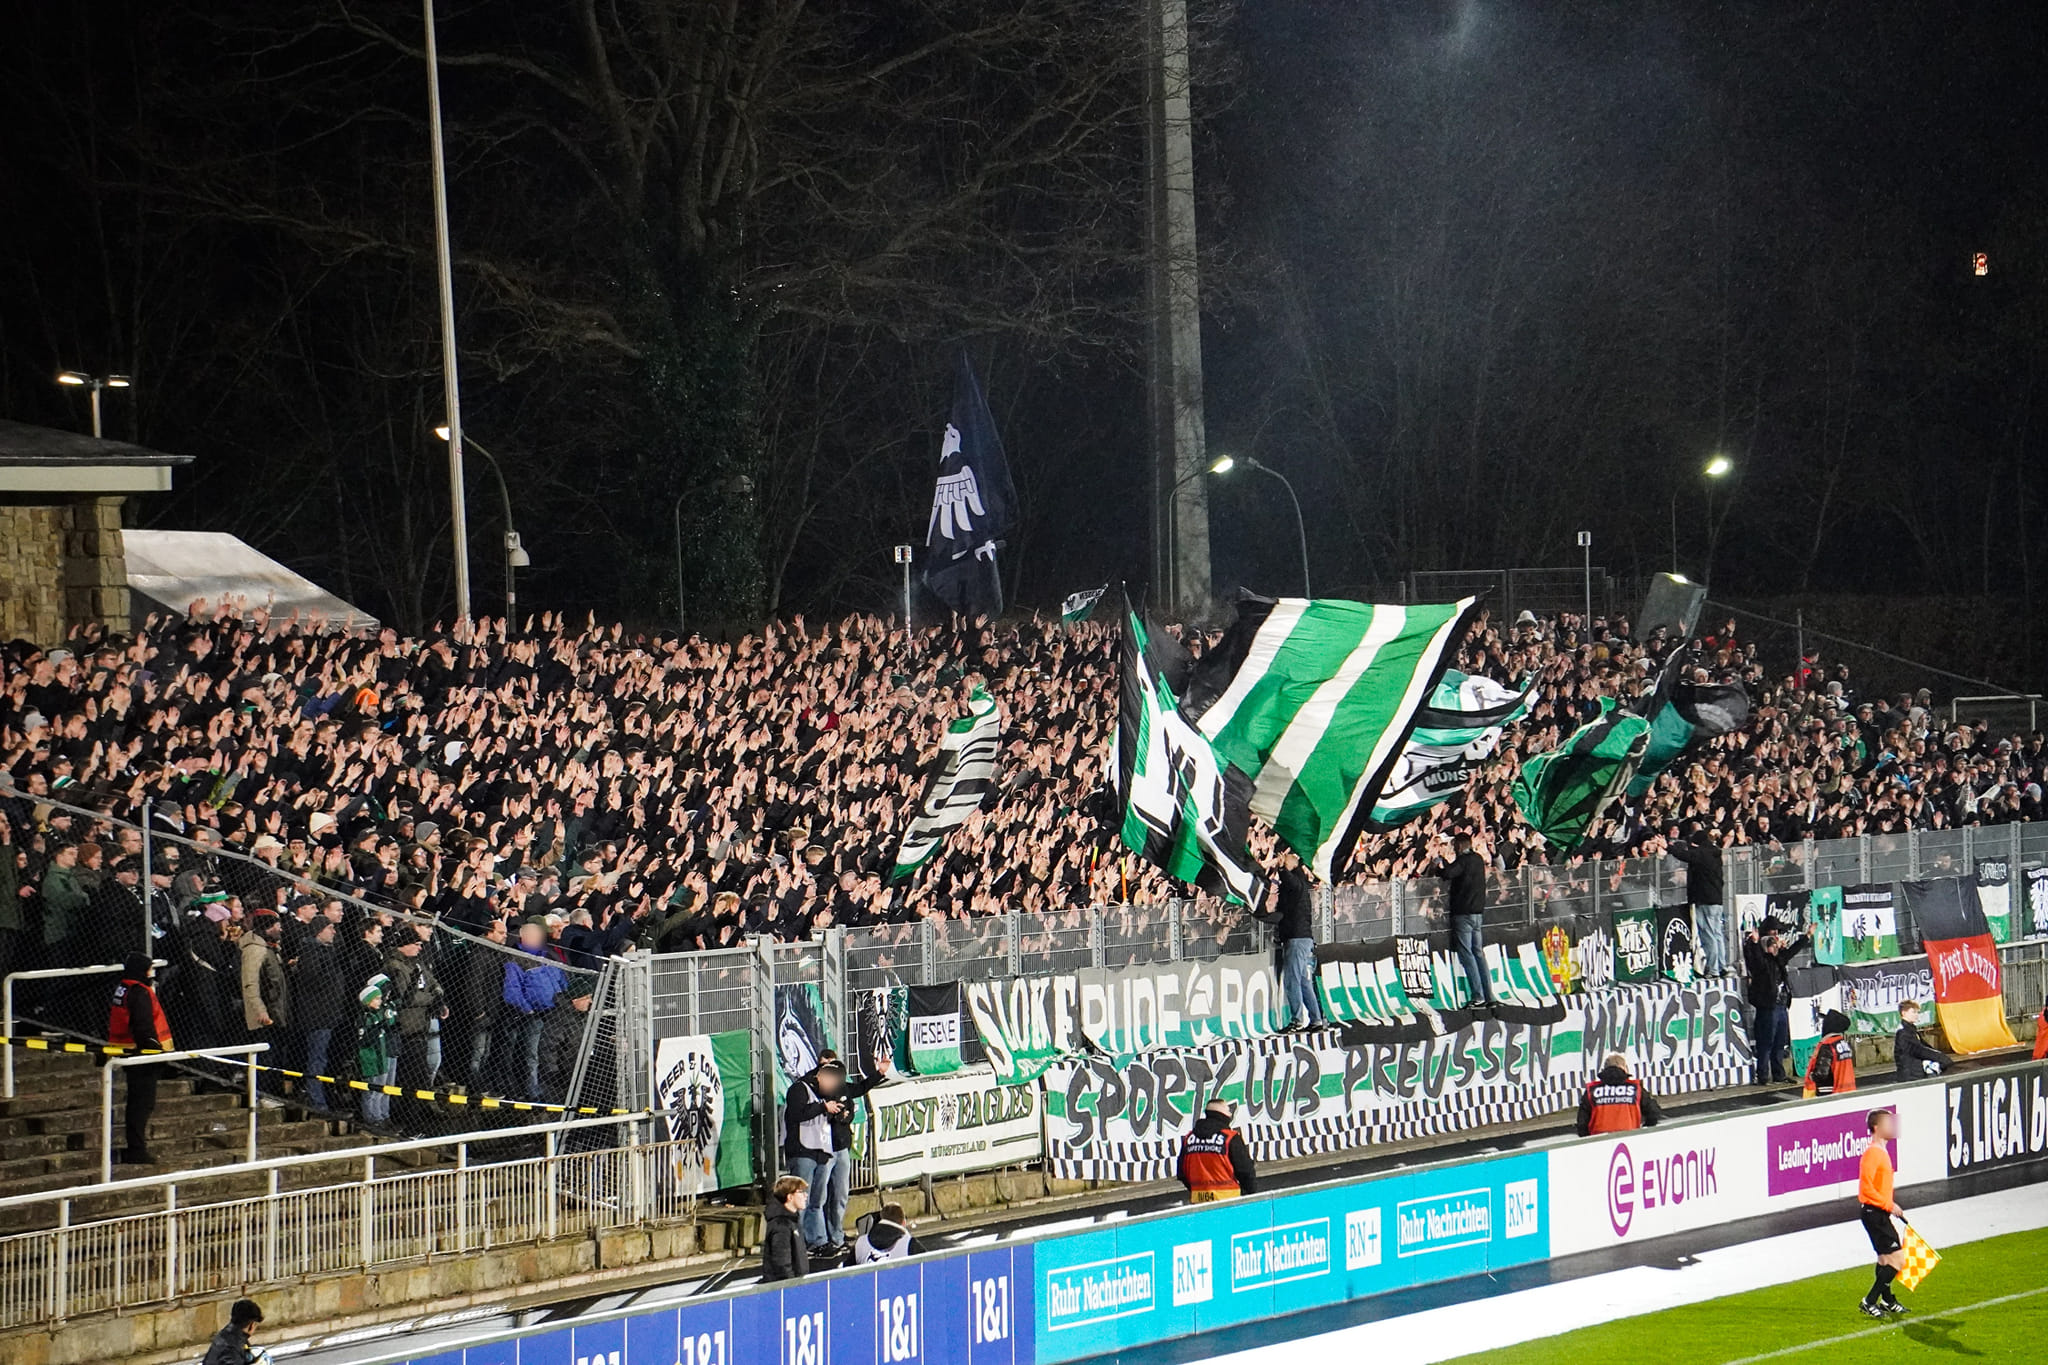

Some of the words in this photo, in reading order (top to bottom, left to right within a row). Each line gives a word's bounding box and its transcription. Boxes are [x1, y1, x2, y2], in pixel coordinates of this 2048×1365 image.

[1424, 768, 1477, 788] MÜNST
[659, 1059, 686, 1100] BEER
[700, 1053, 721, 1095] LOVE
[878, 1096, 939, 1142] WEST
[955, 1082, 1034, 1130] EAGLES
[1949, 1086, 1970, 1169] 3.
[1972, 1076, 2025, 1163] LIGA
[1778, 1140, 1811, 1174] Leading
[1811, 1132, 1844, 1171] Beyond
[1844, 1128, 1873, 1158] Chemi
[1401, 1209, 1426, 1246] Ruhr
[1426, 1199, 1489, 1241] Nachrichten
[1508, 1191, 1535, 1228] RN+
[1235, 1241, 1263, 1280] Ruhr
[1264, 1230, 1327, 1274] Nachrichten
[1349, 1219, 1378, 1259] RN+
[1051, 1276, 1081, 1317] Ruhr
[1083, 1265, 1151, 1311] Nachrichten
[1177, 1253, 1208, 1295] RN+
[879, 1293, 918, 1364] 1&1
[972, 1275, 1009, 1345] 1&1
[785, 1312, 824, 1365] 1&1
